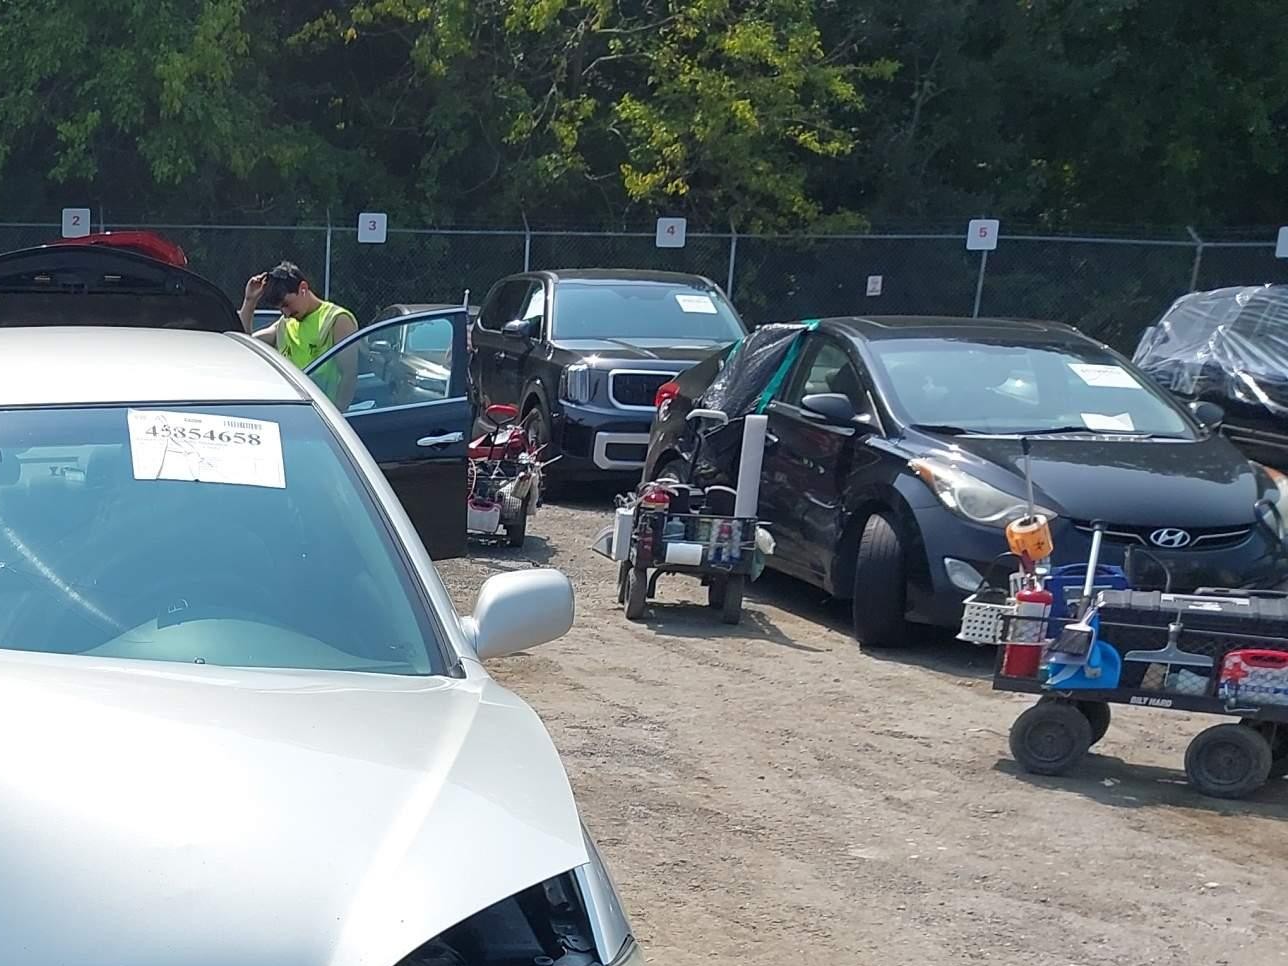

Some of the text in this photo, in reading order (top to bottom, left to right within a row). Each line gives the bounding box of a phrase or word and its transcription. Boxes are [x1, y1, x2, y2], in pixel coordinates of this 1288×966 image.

[72, 216, 80, 226] 2
[368, 220, 377, 231] 3
[666, 225, 676, 236] 4
[978, 227, 988, 238] 5
[145, 424, 262, 446] 45854658
